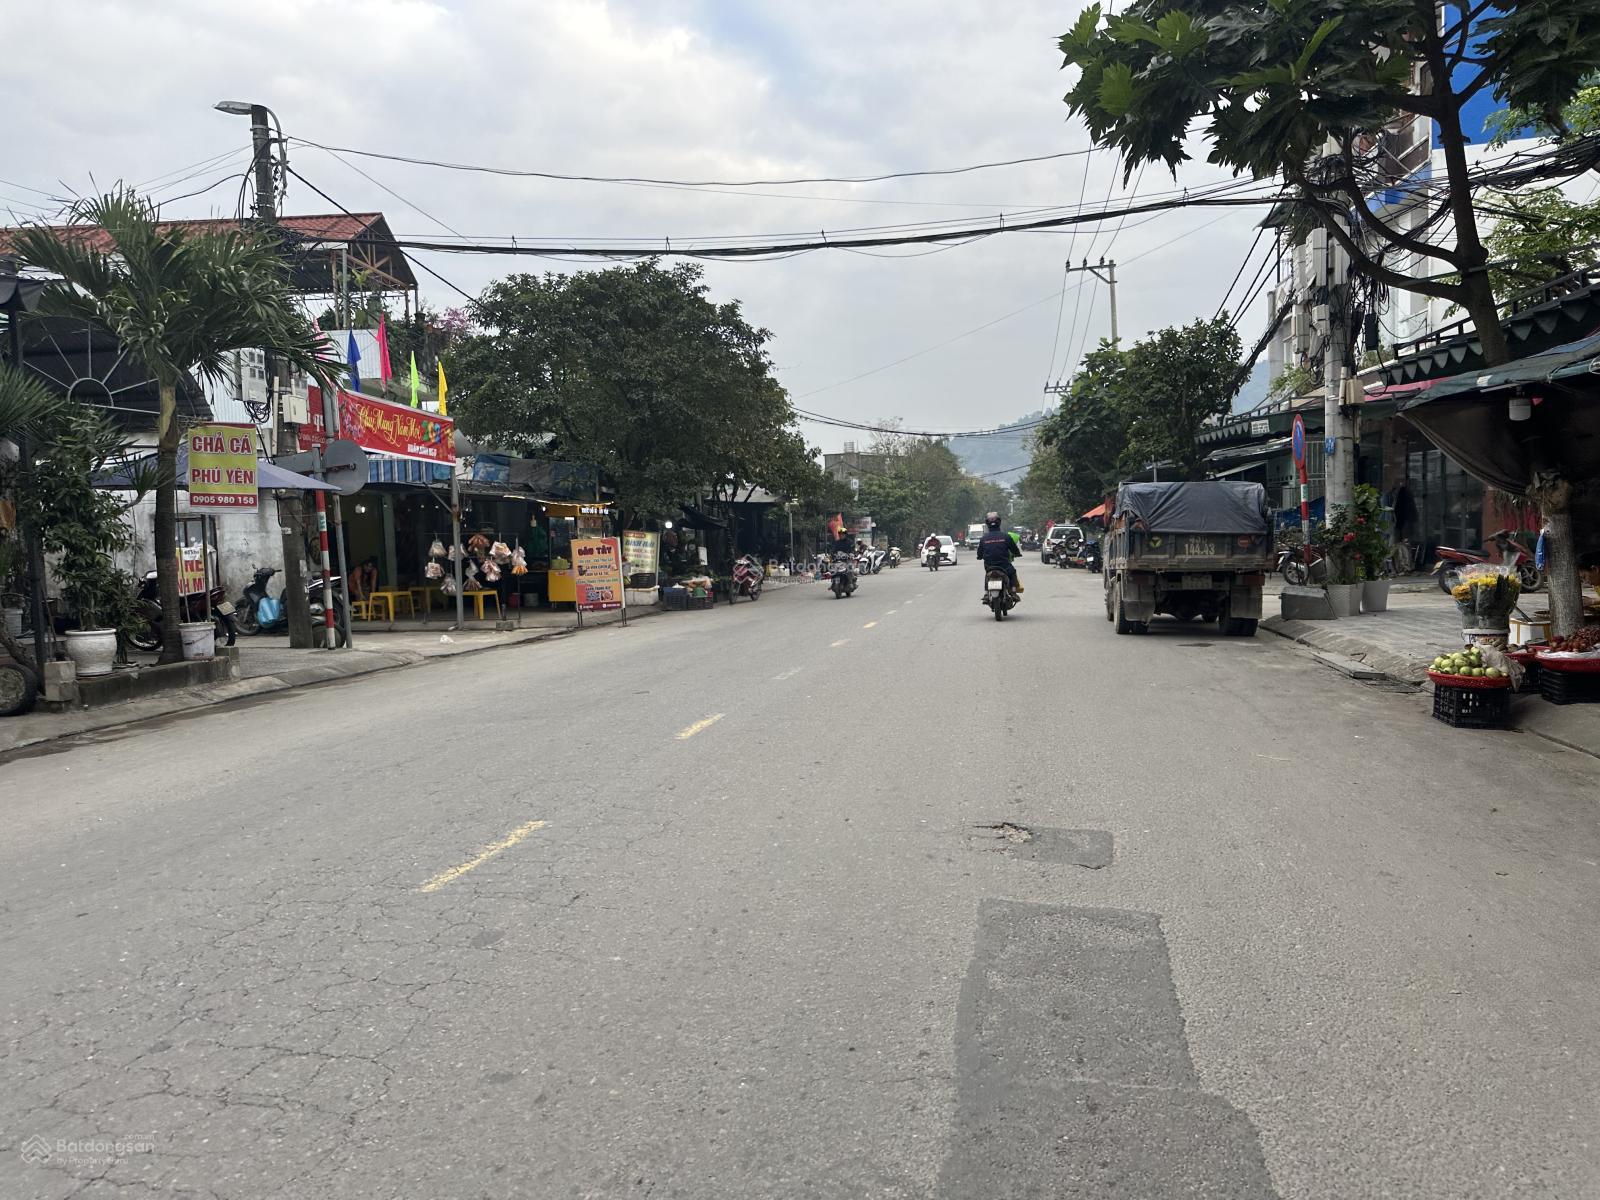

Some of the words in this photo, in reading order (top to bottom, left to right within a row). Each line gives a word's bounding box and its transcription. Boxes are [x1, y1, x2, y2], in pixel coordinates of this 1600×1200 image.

[192, 431, 225, 453] CHẢ
[229, 433, 252, 454] CÁ
[191, 466, 221, 483] PHÚ
[226, 467, 255, 484] YÊN
[193, 495, 215, 503] 0905
[218, 496, 234, 504] 980
[238, 497, 254, 505] 158
